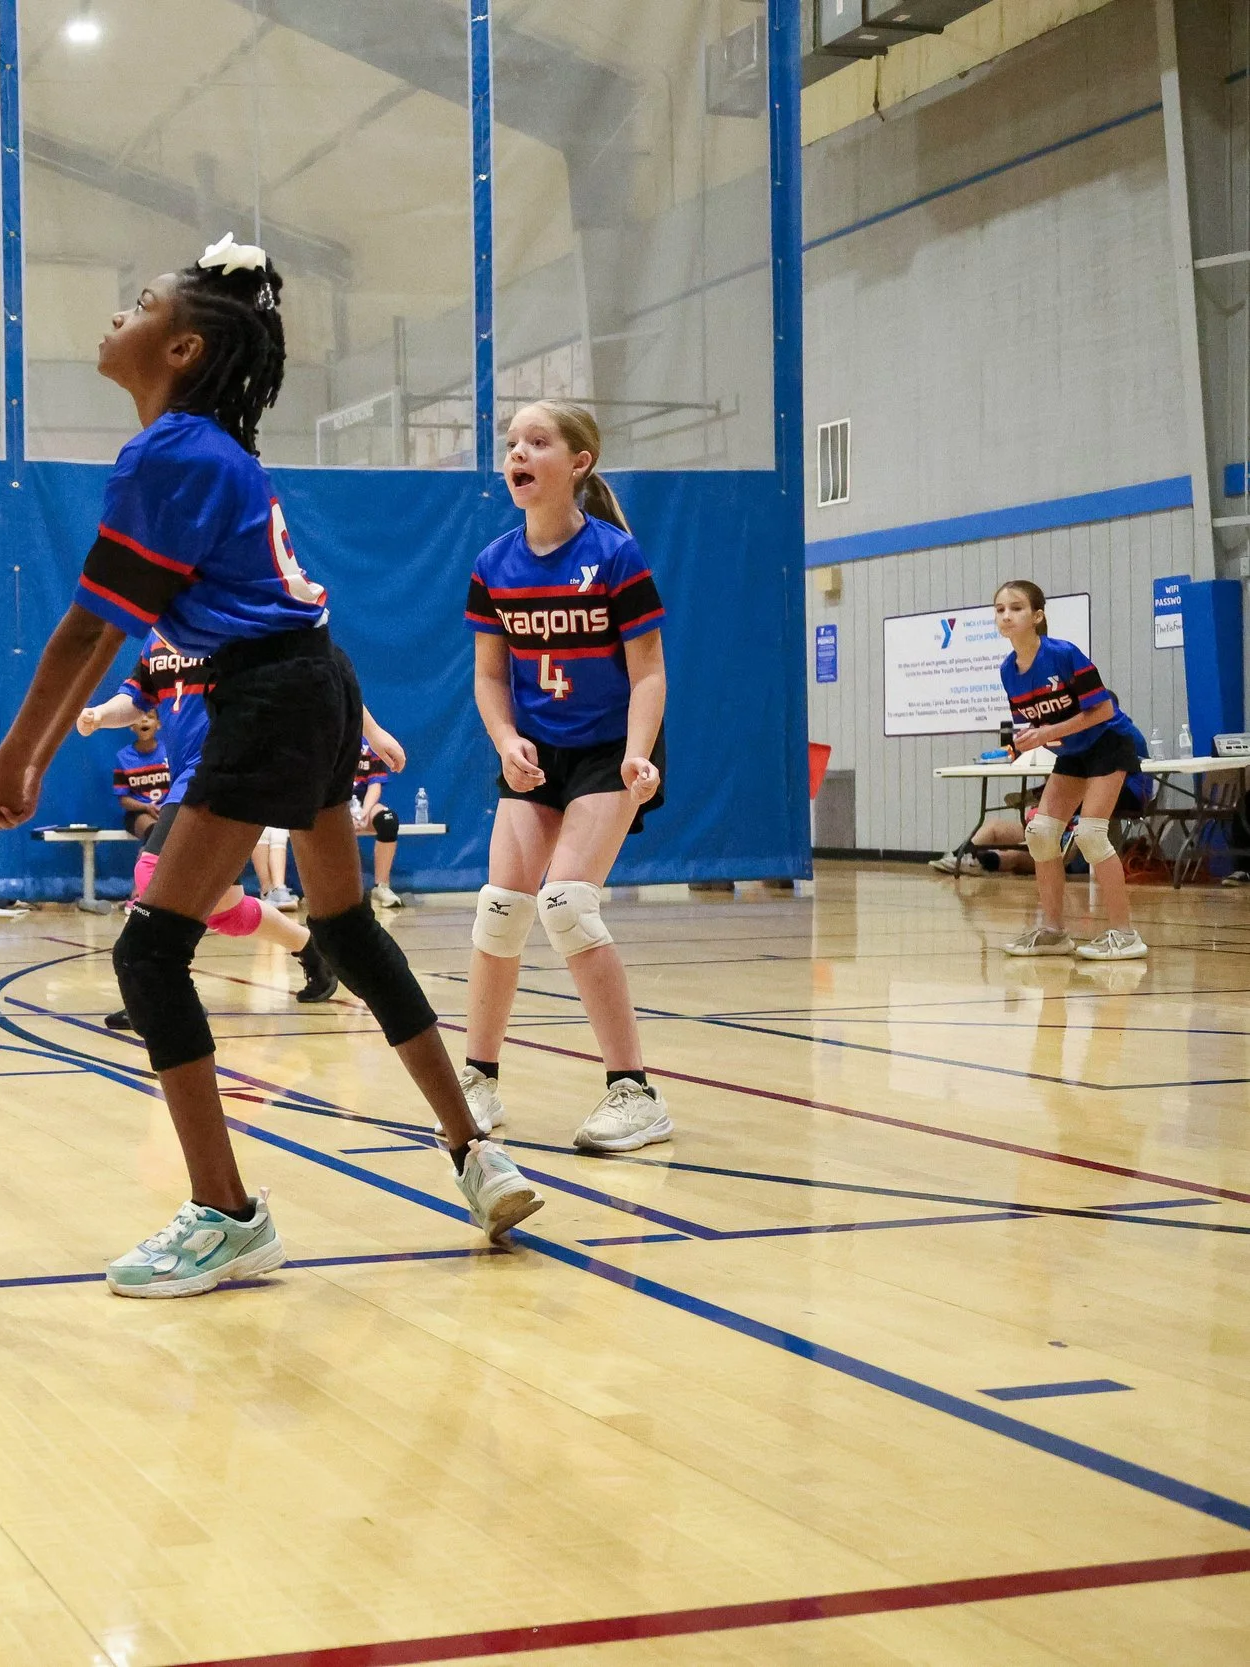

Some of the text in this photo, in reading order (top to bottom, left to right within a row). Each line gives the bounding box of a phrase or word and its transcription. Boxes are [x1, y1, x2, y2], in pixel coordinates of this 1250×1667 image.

[1165, 585, 1179, 594] WIFI
[149, 655, 211, 675] ragon
[540, 654, 569, 698] 4
[173, 682, 183, 711] 1
